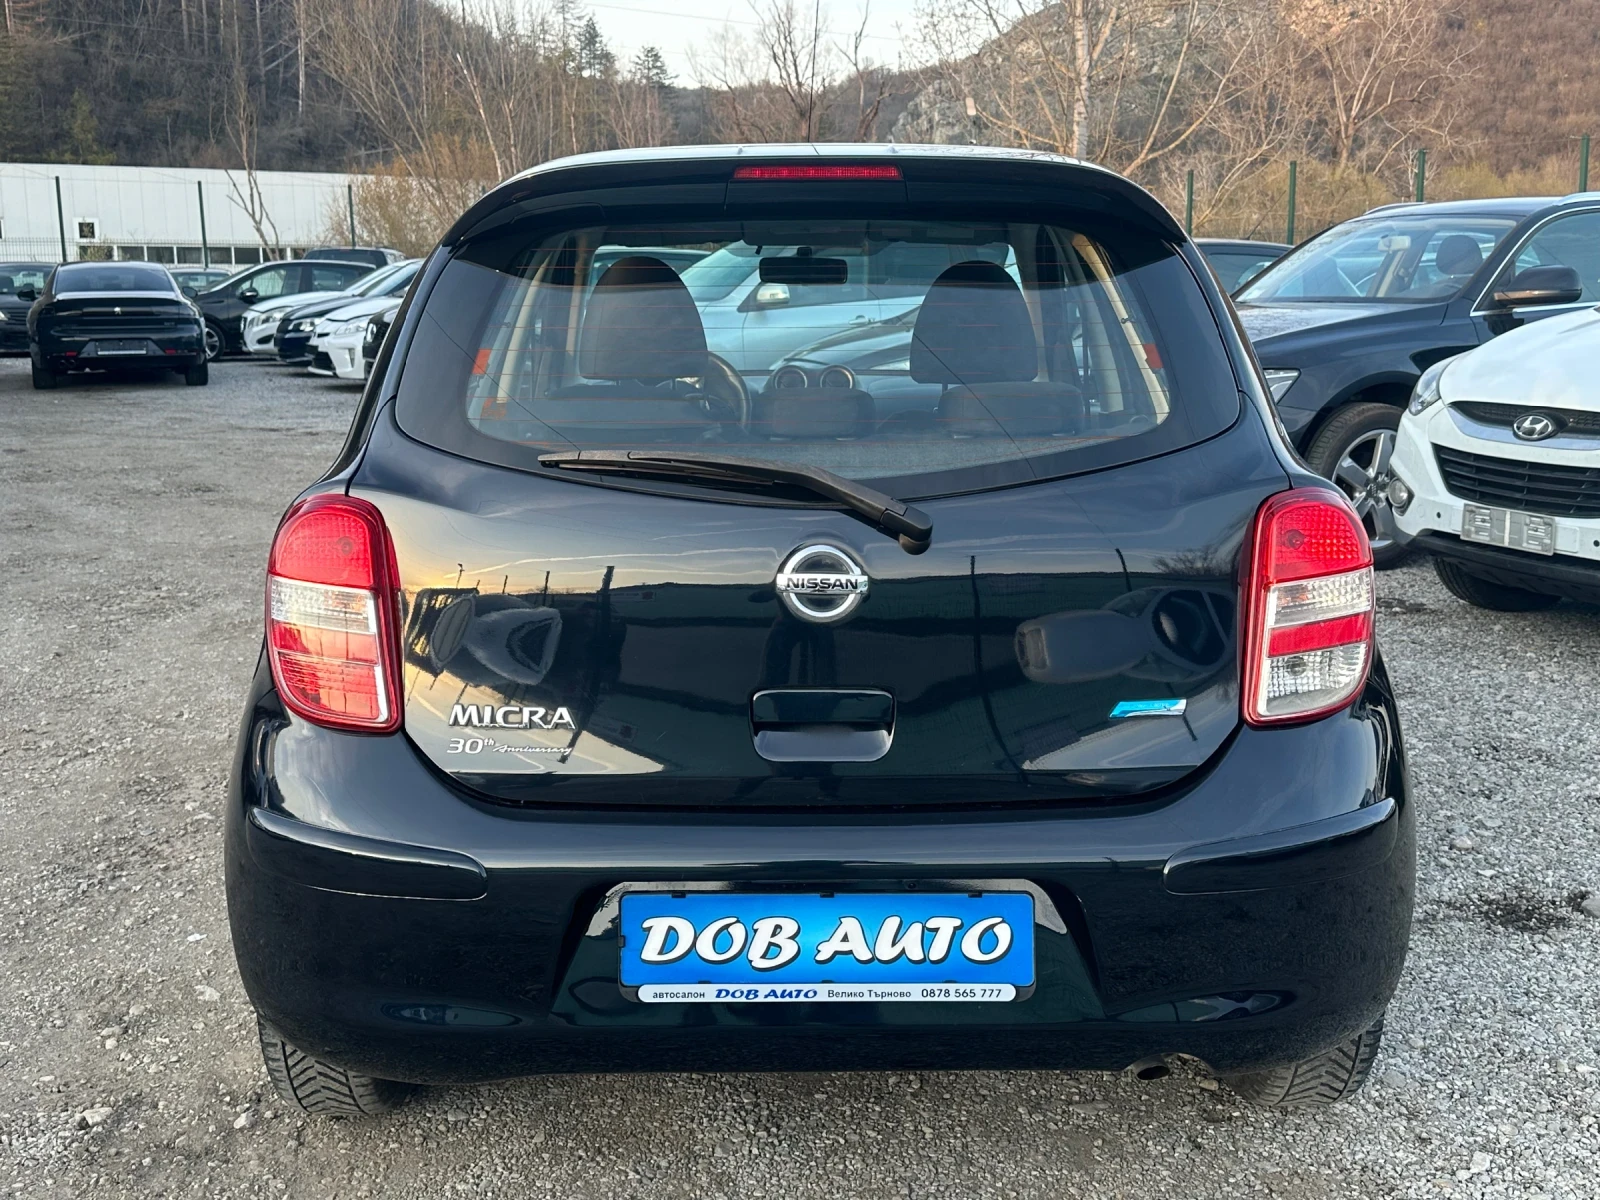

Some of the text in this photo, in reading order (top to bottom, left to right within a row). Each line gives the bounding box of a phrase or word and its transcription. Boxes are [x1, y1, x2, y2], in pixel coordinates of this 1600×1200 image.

[786, 577, 858, 590] NISSAN
[449, 703, 578, 729] MICRA
[447, 738, 572, 756] 30th Anniversary
[640, 915, 1013, 971] DOB AUTO
[652, 988, 1002, 1000] автосалон DOB AUTO Велико Търново 0878 565 777
